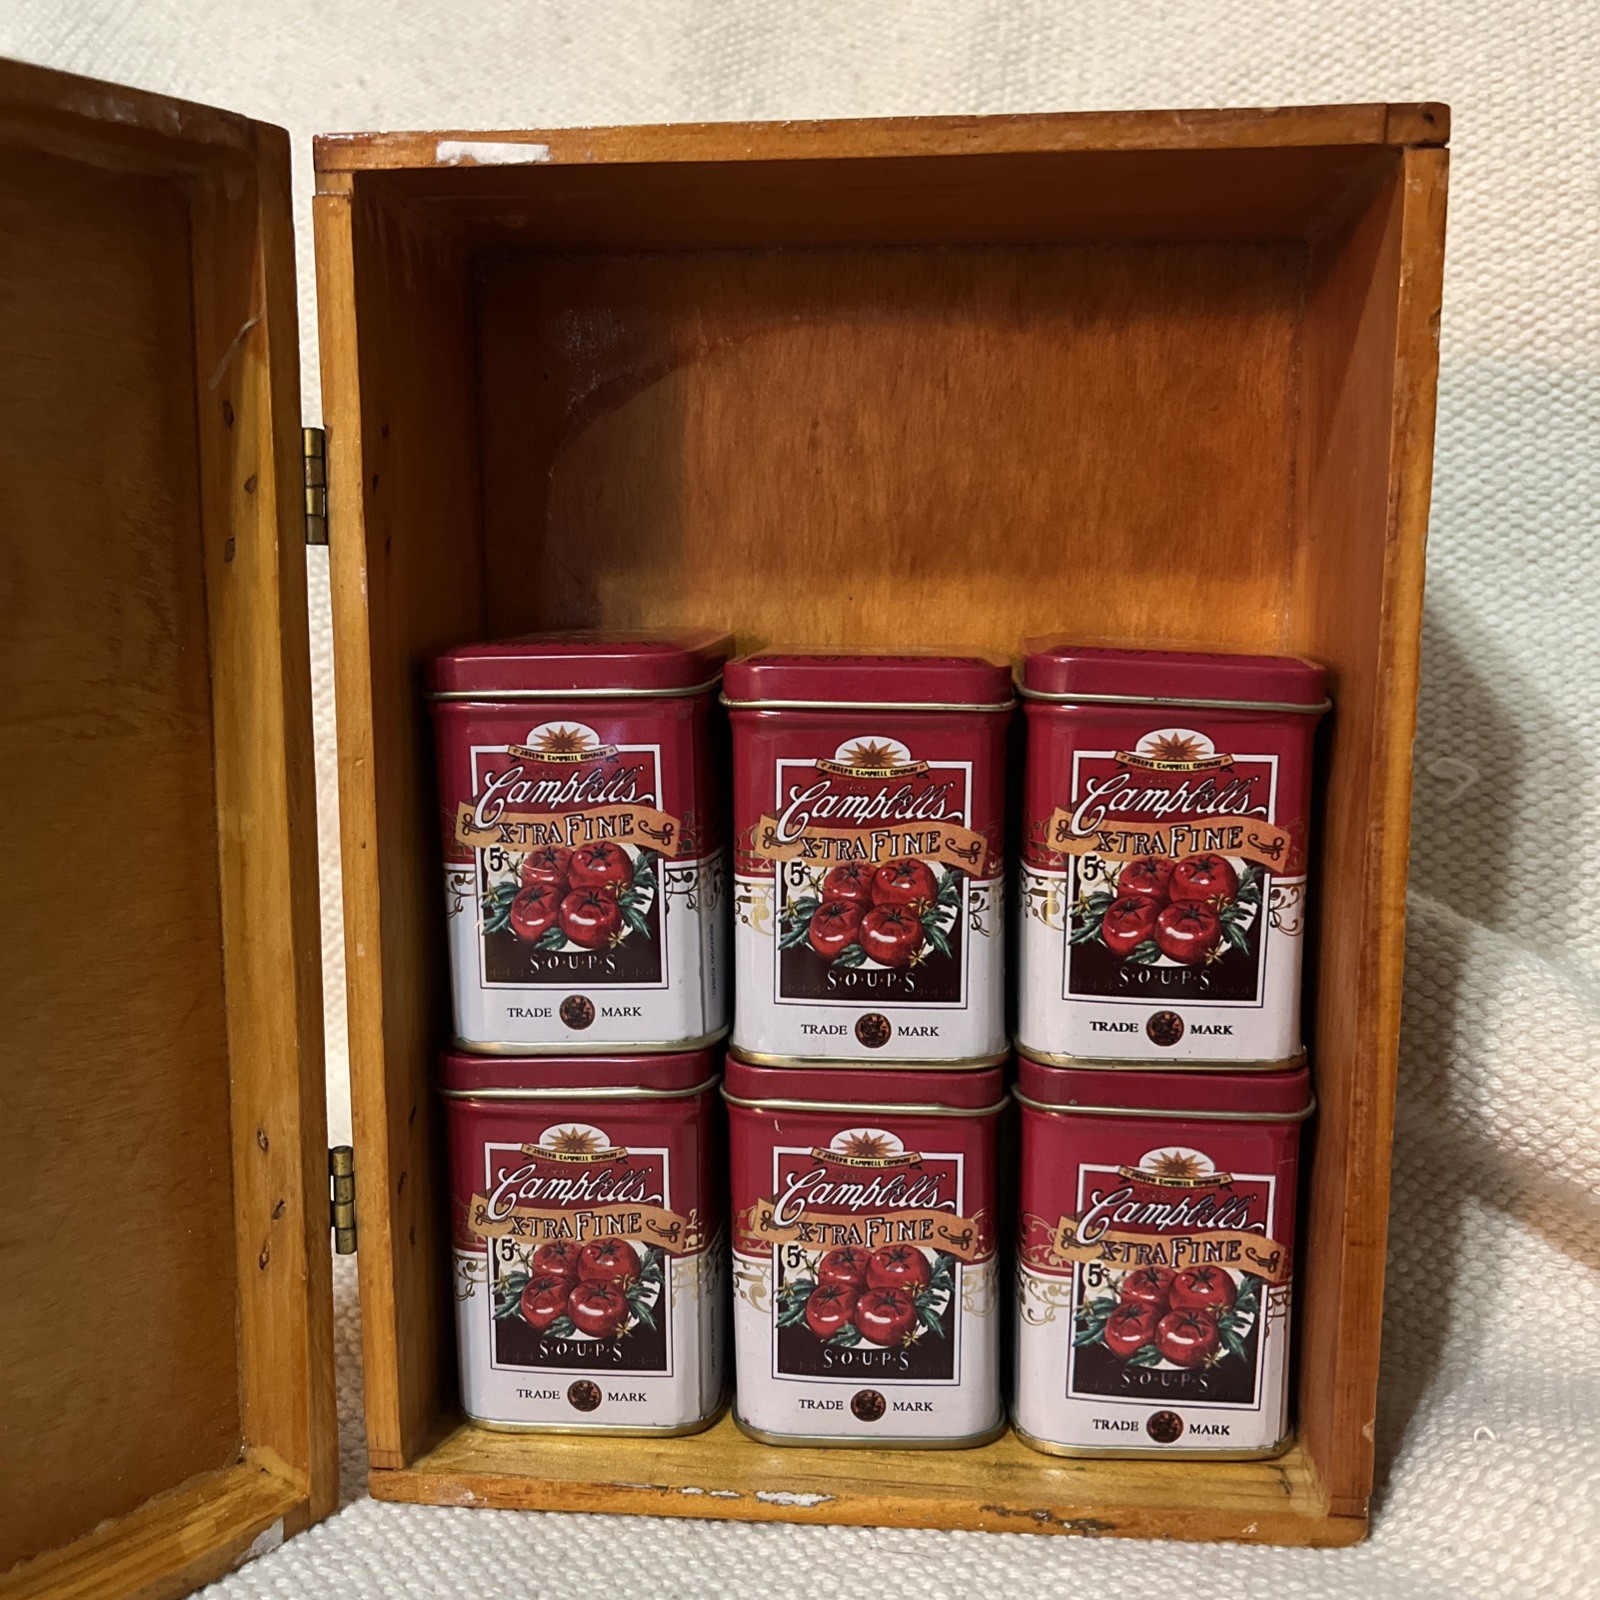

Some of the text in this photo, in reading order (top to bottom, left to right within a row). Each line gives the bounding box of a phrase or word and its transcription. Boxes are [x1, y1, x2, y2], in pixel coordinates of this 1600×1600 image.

[520, 749, 607, 762] JOSEPH CAMPBELL COMPANY
[828, 763, 917, 777] JOSEPH CAMPBELL COMPANY
[1127, 756, 1221, 770] JOSEPH CAMPBELL COMPANY
[475, 765, 654, 829] Campbell's
[777, 781, 963, 842] Campbell's
[1070, 773, 1267, 836] Campbell's
[564, 813, 634, 847] FINE
[1168, 824, 1243, 858] FINE
[869, 831, 941, 863] FINE
[507, 1006, 642, 1018] TRADE MARK
[801, 1024, 939, 1037] TRADE MARK
[1090, 1021, 1234, 1035] TRADE MARK
[533, 1148, 617, 1162] JOSEPH CAMPBELL COMPANY
[823, 1152, 911, 1167] JOSEPH CAMPBELL COMPANY
[487, 1164, 662, 1220] Campbell's
[773, 1168, 955, 1226] Campbell's
[575, 1211, 642, 1242] FINE
[865, 1216, 934, 1248] FINE
[1076, 1188, 1265, 1245] Campbell's
[1169, 1237, 1242, 1268] FINE
[516, 1389, 647, 1403] TRADE MARK
[799, 1399, 933, 1412] TRADE MARK
[1092, 1418, 1230, 1436] TRADE MARK
